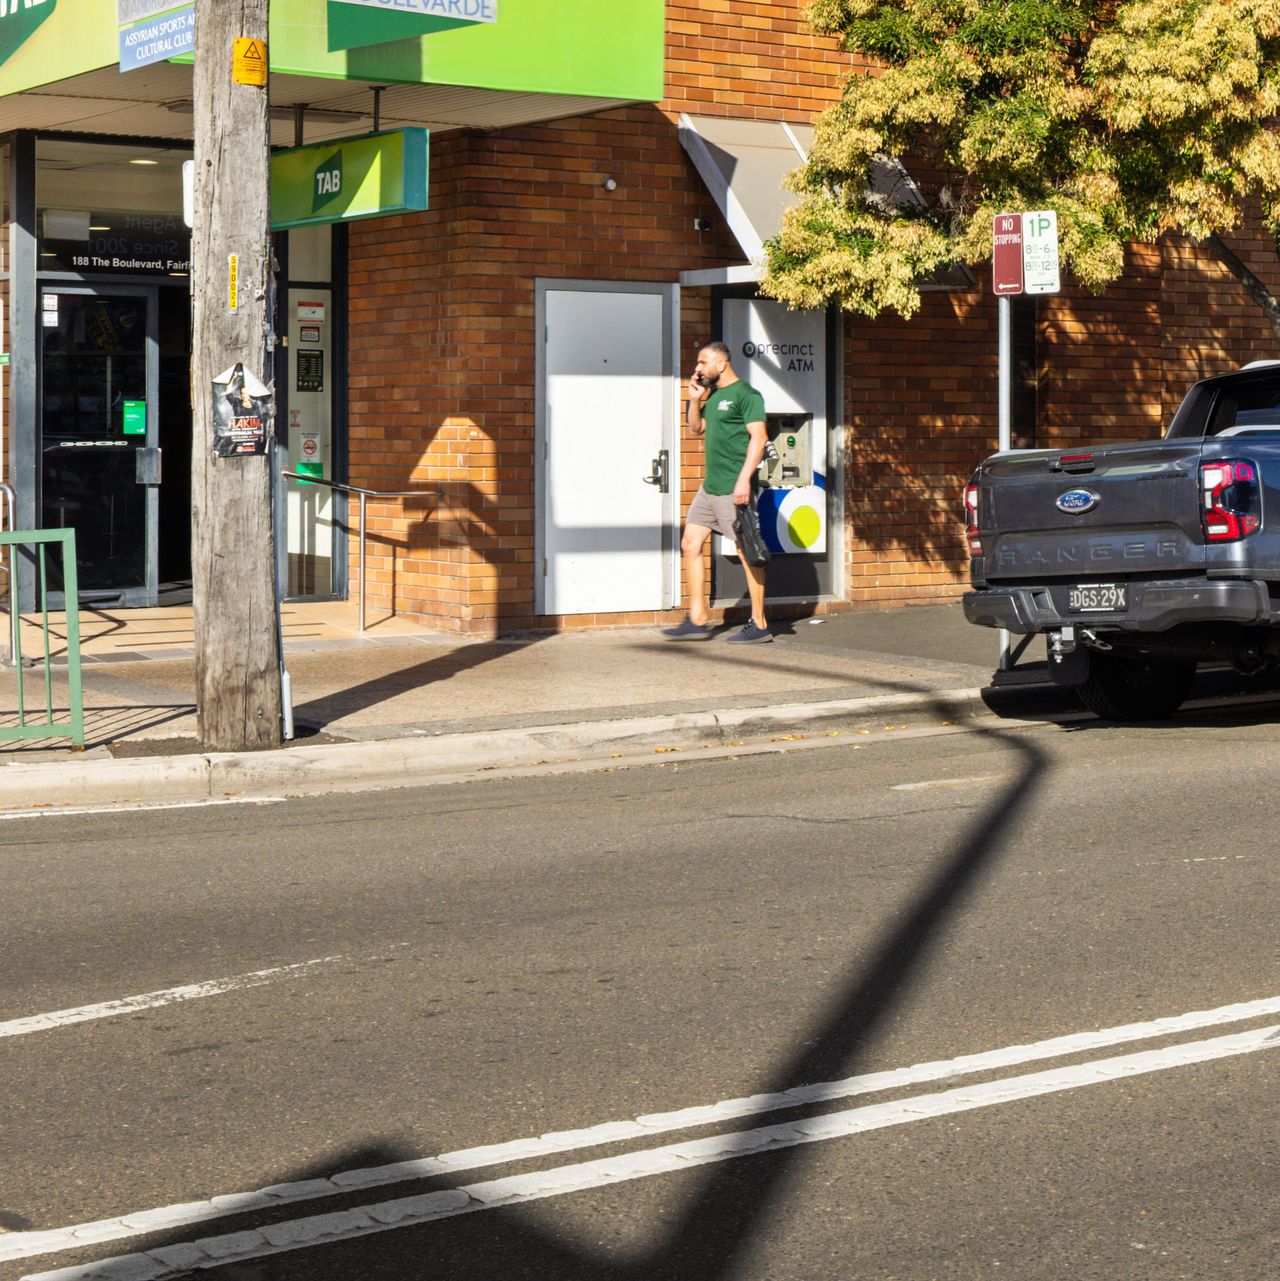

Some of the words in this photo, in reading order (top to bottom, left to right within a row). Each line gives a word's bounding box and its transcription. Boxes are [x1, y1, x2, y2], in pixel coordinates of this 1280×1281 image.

[125, 25, 159, 47] ASSYRIAN
[160, 17, 186, 35] SPORTS
[137, 39, 173, 60] CULTURAL
[174, 32, 193, 48] CLUB
[316, 170, 341, 196] TAB
[1002, 218, 1014, 231] NO
[1029, 218, 1051, 237] 1P
[994, 233, 1021, 245] STOPPING
[72, 256, 89, 266] 188
[92, 257, 110, 267] The
[112, 257, 165, 270] Boulevard,
[757, 342, 814, 359] precinct
[787, 359, 814, 372] ATM
[1064, 494, 1085, 507] Ford
[999, 542, 1181, 566] RANGER
